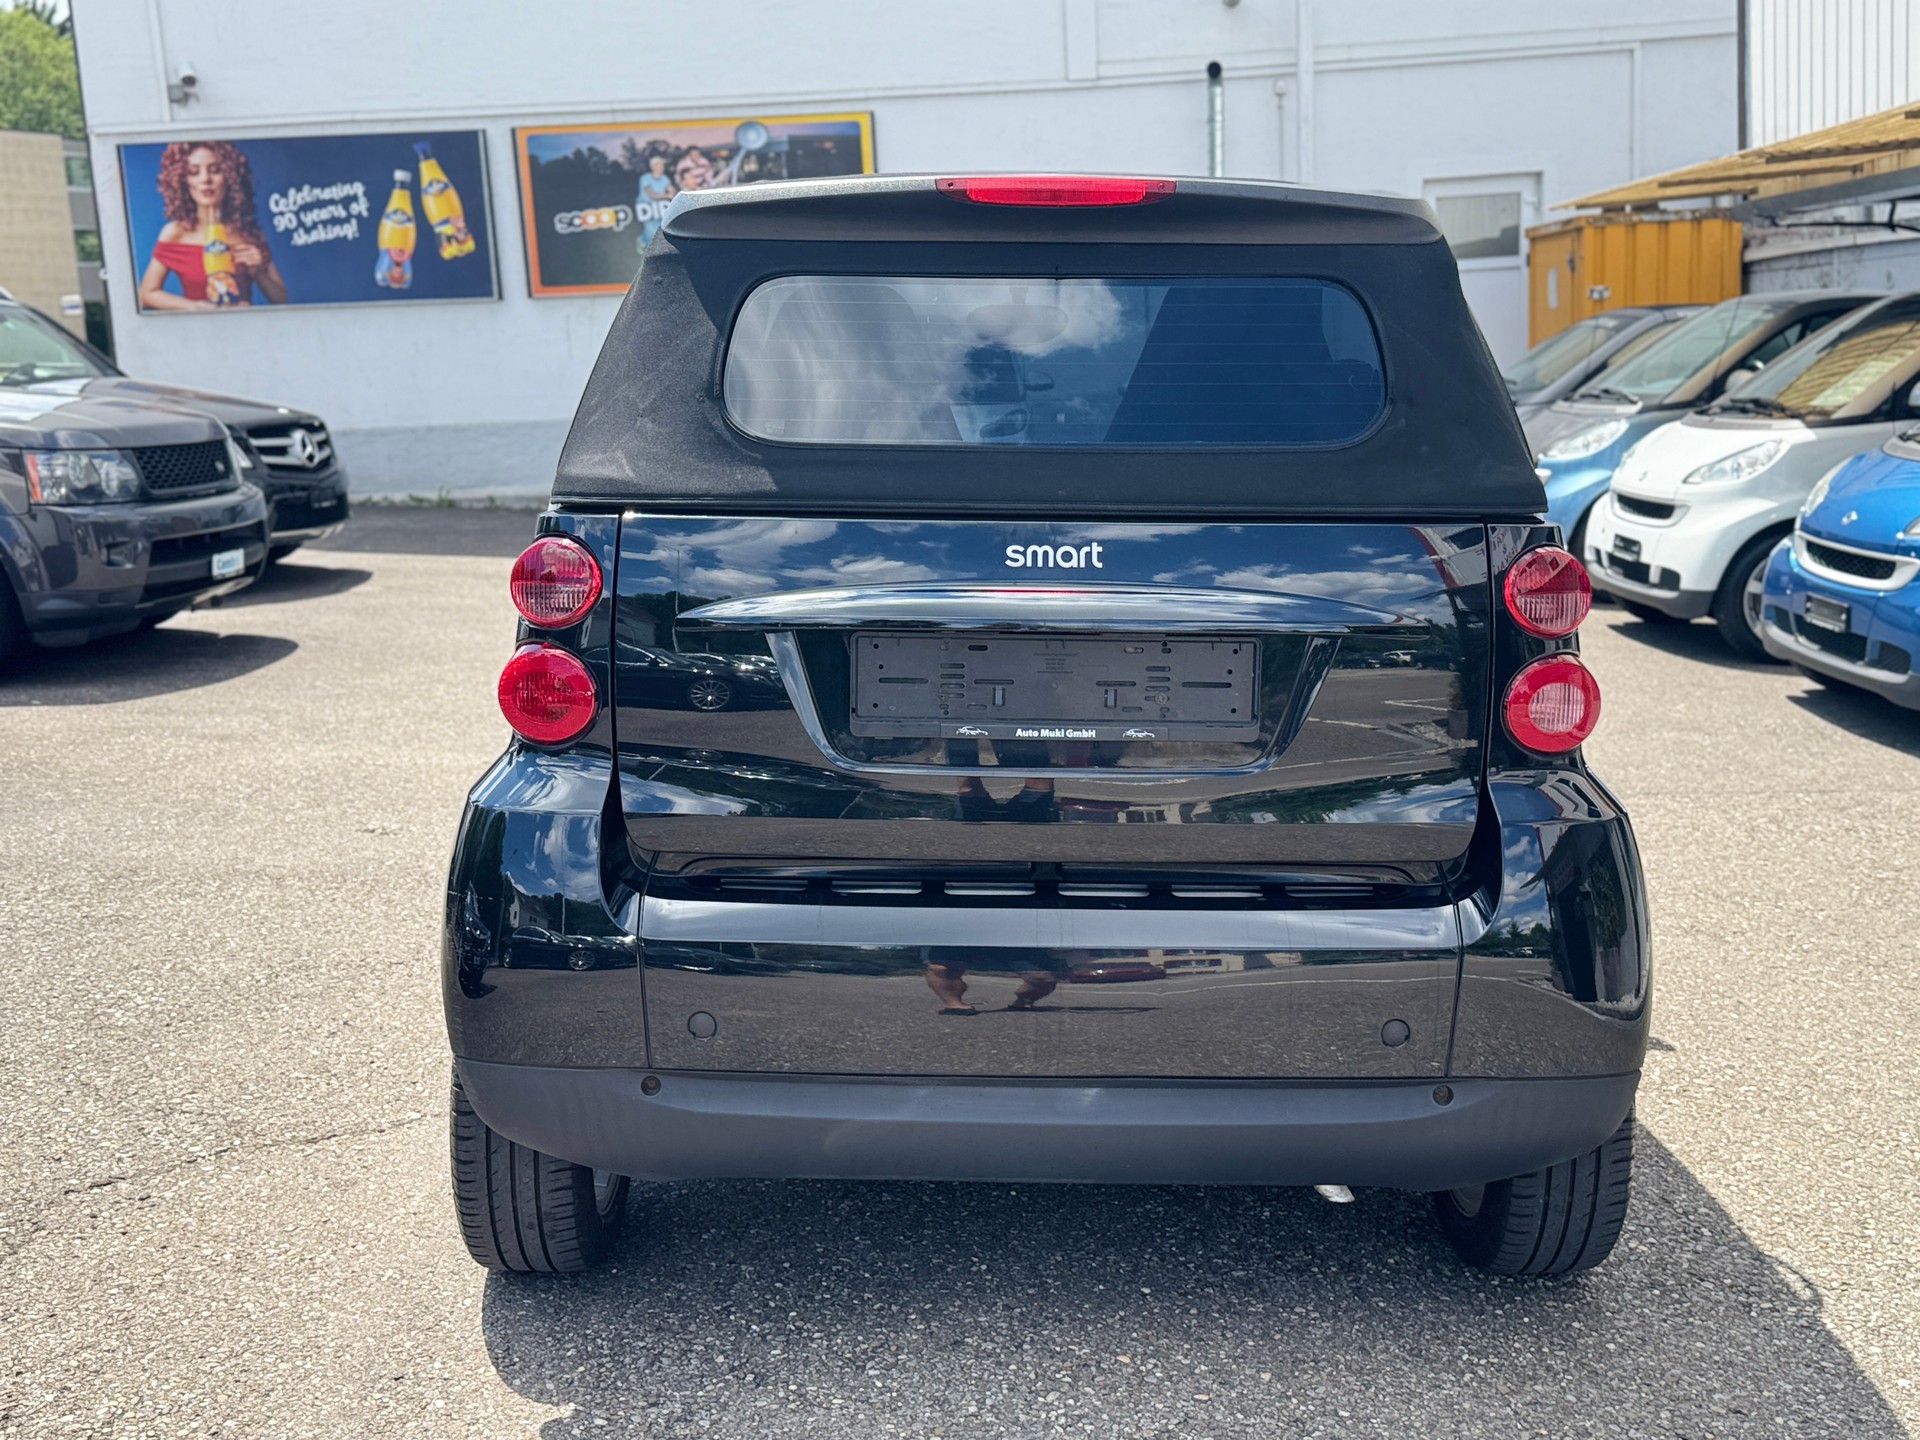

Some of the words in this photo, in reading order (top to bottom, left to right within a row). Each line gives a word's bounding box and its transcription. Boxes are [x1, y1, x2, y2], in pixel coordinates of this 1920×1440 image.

[269, 181, 366, 213] Celebrating
[273, 212, 298, 232] 90
[300, 204, 348, 228] years
[349, 197, 370, 218] of
[291, 216, 360, 246] shaking!
[1004, 541, 1104, 569] smart
[1015, 728, 1039, 738] Auto
[1040, 728, 1064, 738] Muki
[1065, 728, 1097, 739] GmbH
